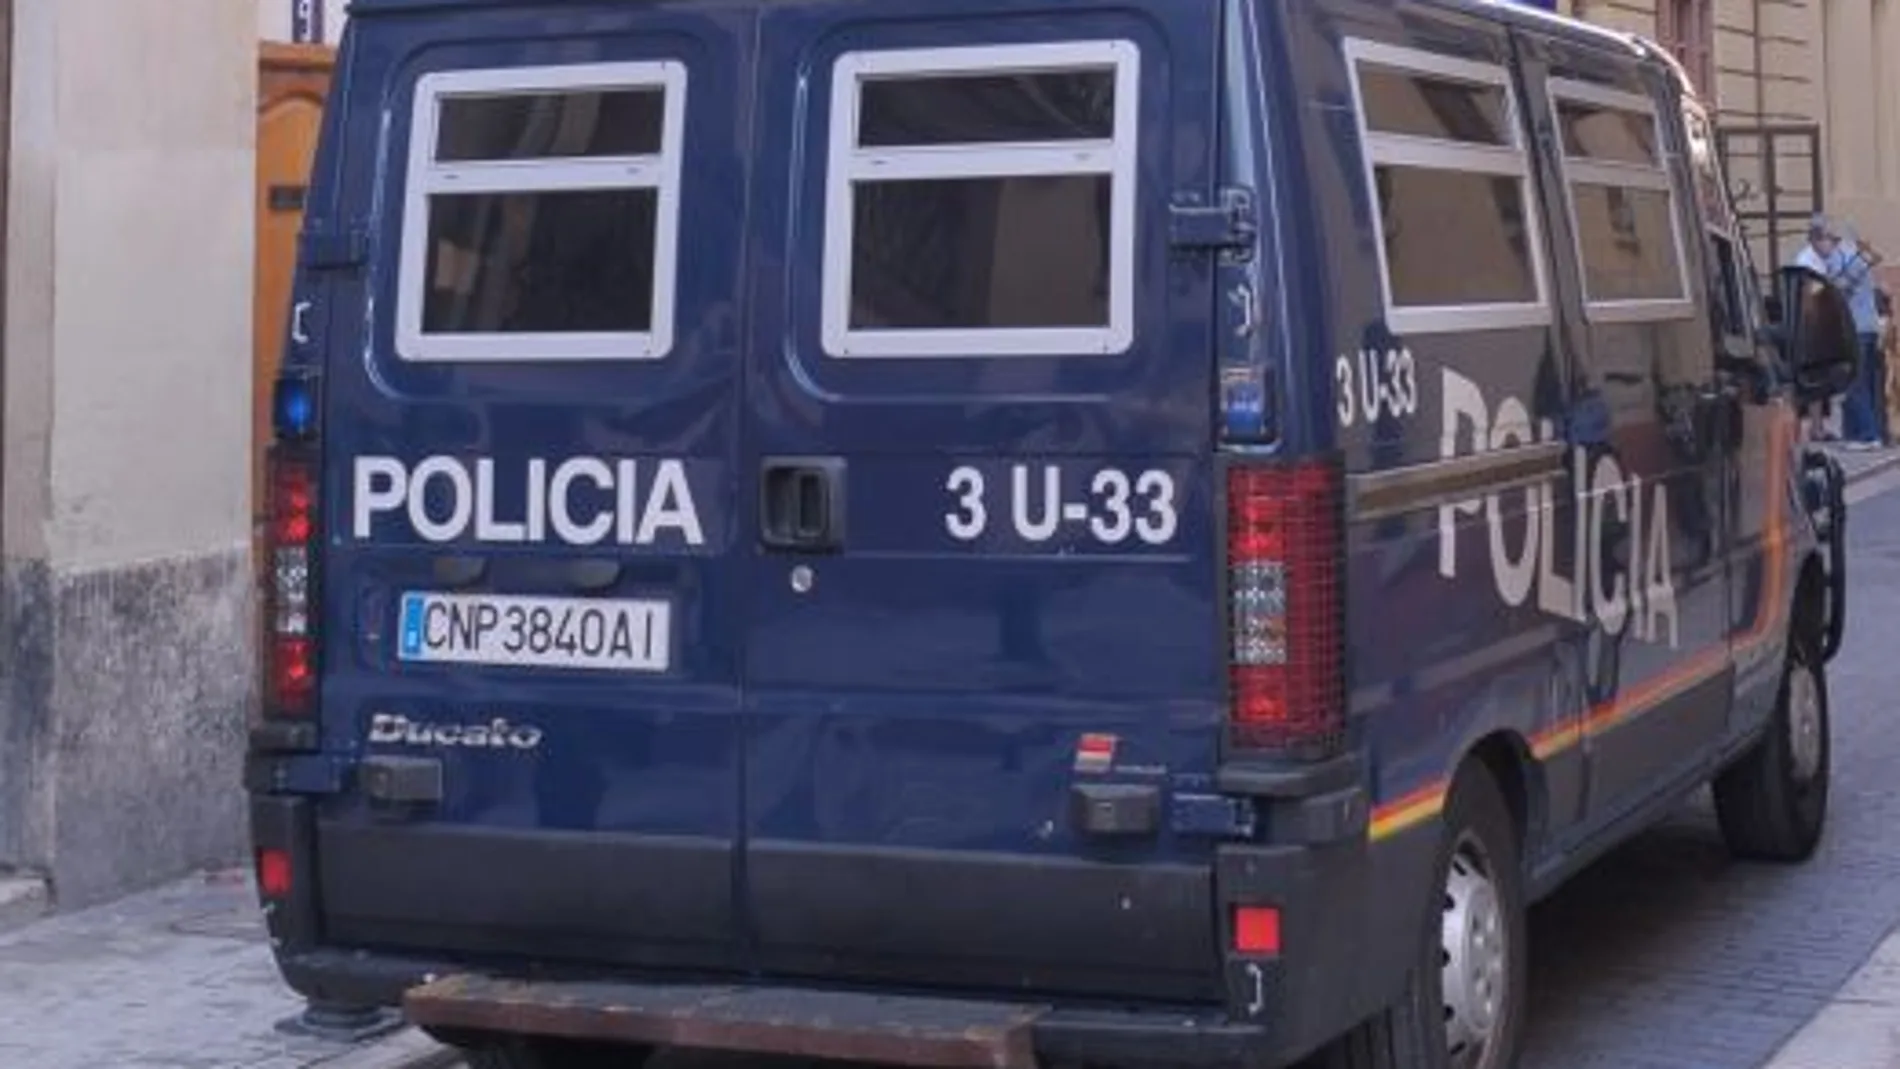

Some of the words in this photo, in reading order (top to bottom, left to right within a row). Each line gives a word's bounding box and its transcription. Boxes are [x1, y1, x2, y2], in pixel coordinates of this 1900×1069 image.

[1336, 354, 1353, 427] 3
[1359, 347, 1416, 422] U-33
[353, 456, 703, 545] POLICIA
[945, 466, 987, 539] 3
[1012, 466, 1178, 543] U-33
[1439, 367, 1678, 648] POLICIA
[368, 713, 543, 749] Ducato
